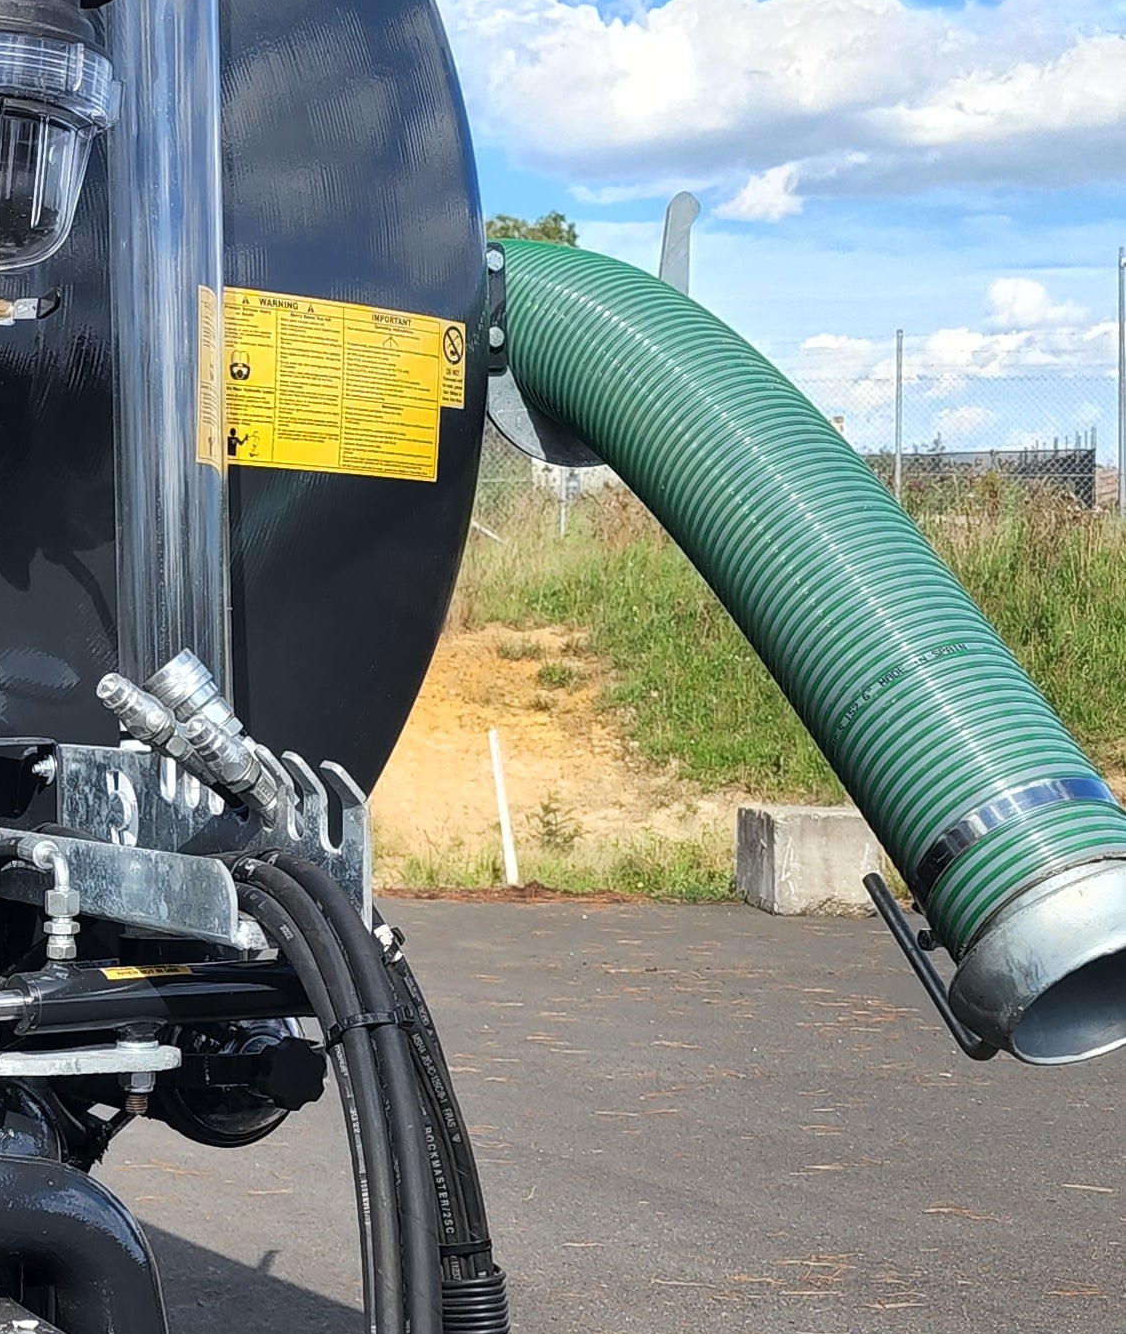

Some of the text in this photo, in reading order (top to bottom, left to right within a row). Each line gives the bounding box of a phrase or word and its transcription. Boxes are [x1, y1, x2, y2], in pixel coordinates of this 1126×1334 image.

[259, 297, 299, 311] WARNING
[371, 314, 412, 327] IMPORTANT
[877, 666, 908, 688] MADE
[931, 643, 970, 659] SPAIN
